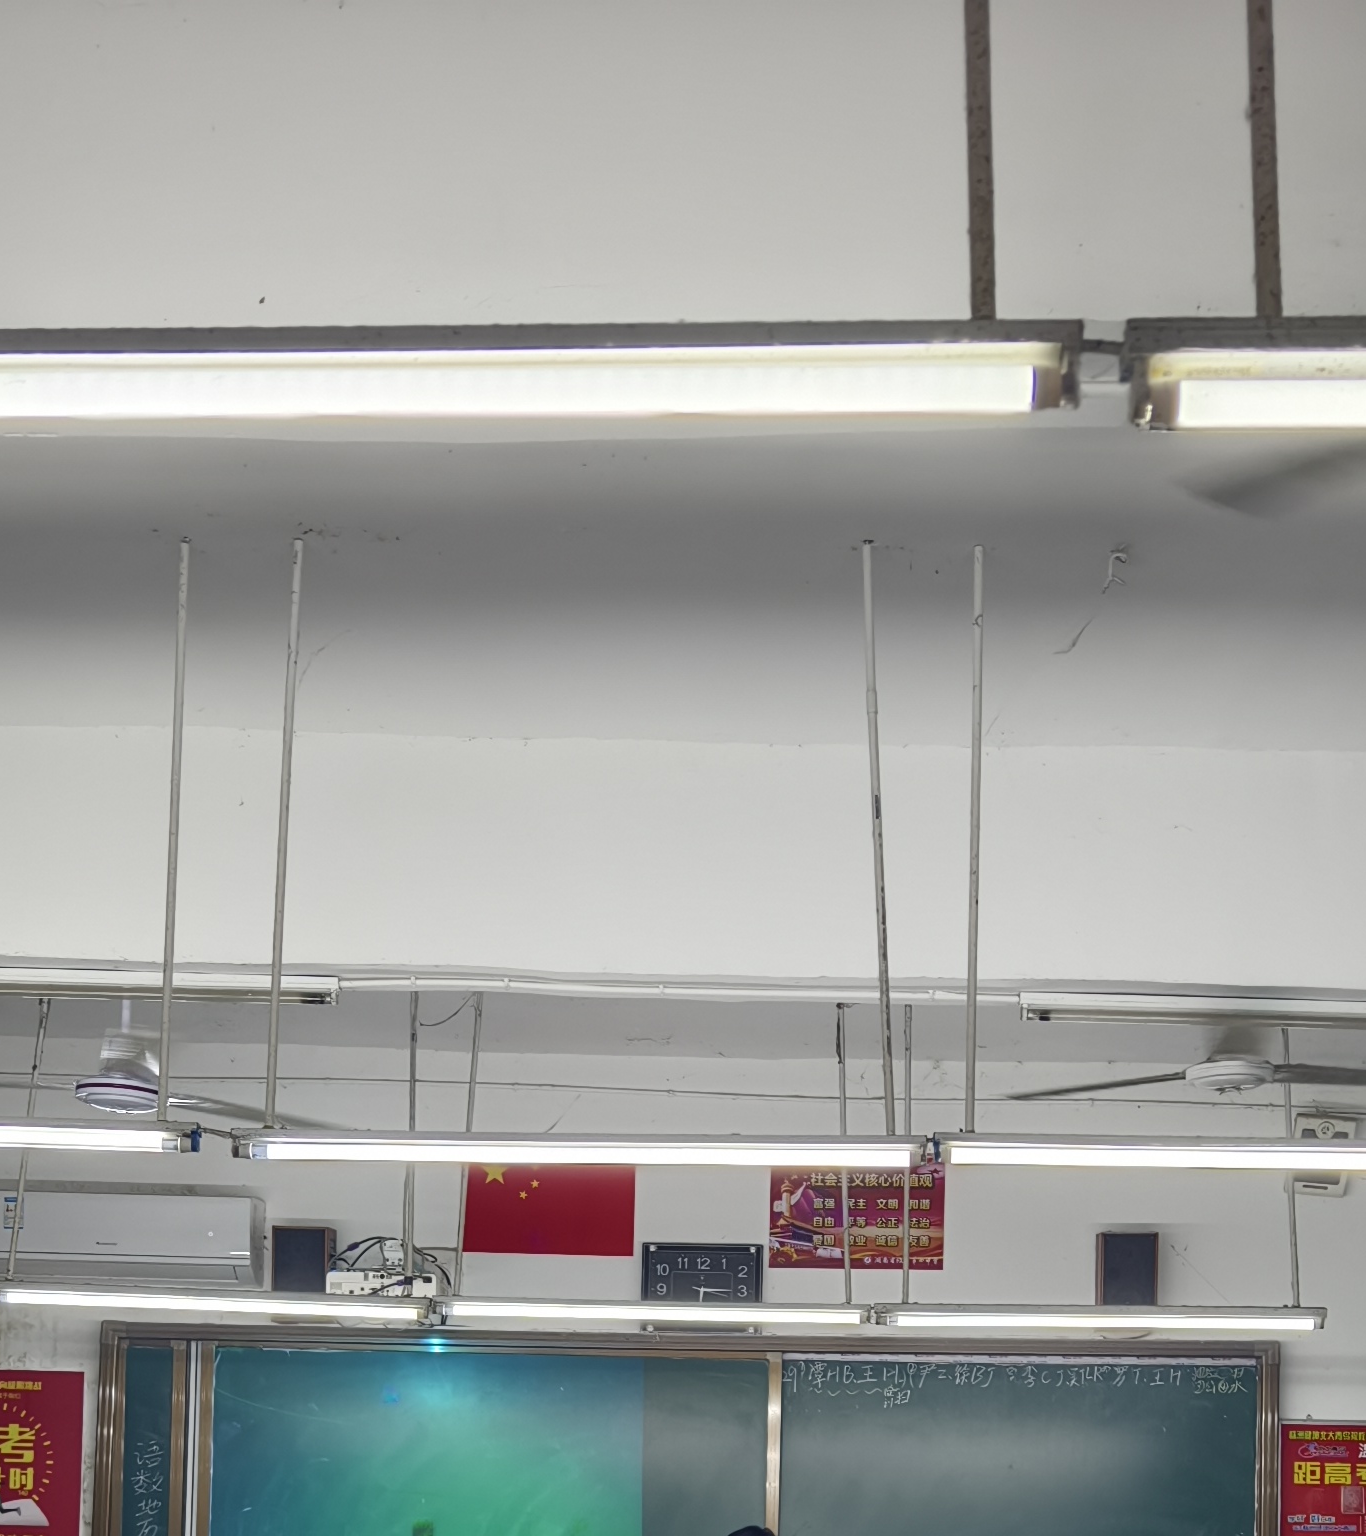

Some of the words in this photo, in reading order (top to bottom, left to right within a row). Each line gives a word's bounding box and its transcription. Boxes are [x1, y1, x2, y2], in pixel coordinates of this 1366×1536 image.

[813, 1216, 835, 1228] 自由
[876, 1216, 900, 1228] 公正
[656, 1263, 669, 1276] 10
[678, 1257, 688, 1270] 11
[696, 1257, 711, 1270] 12
[721, 1258, 727, 1270] 1
[737, 1265, 748, 1278] 2
[656, 1283, 667, 1295] 9
[737, 1285, 748, 1298] 3
